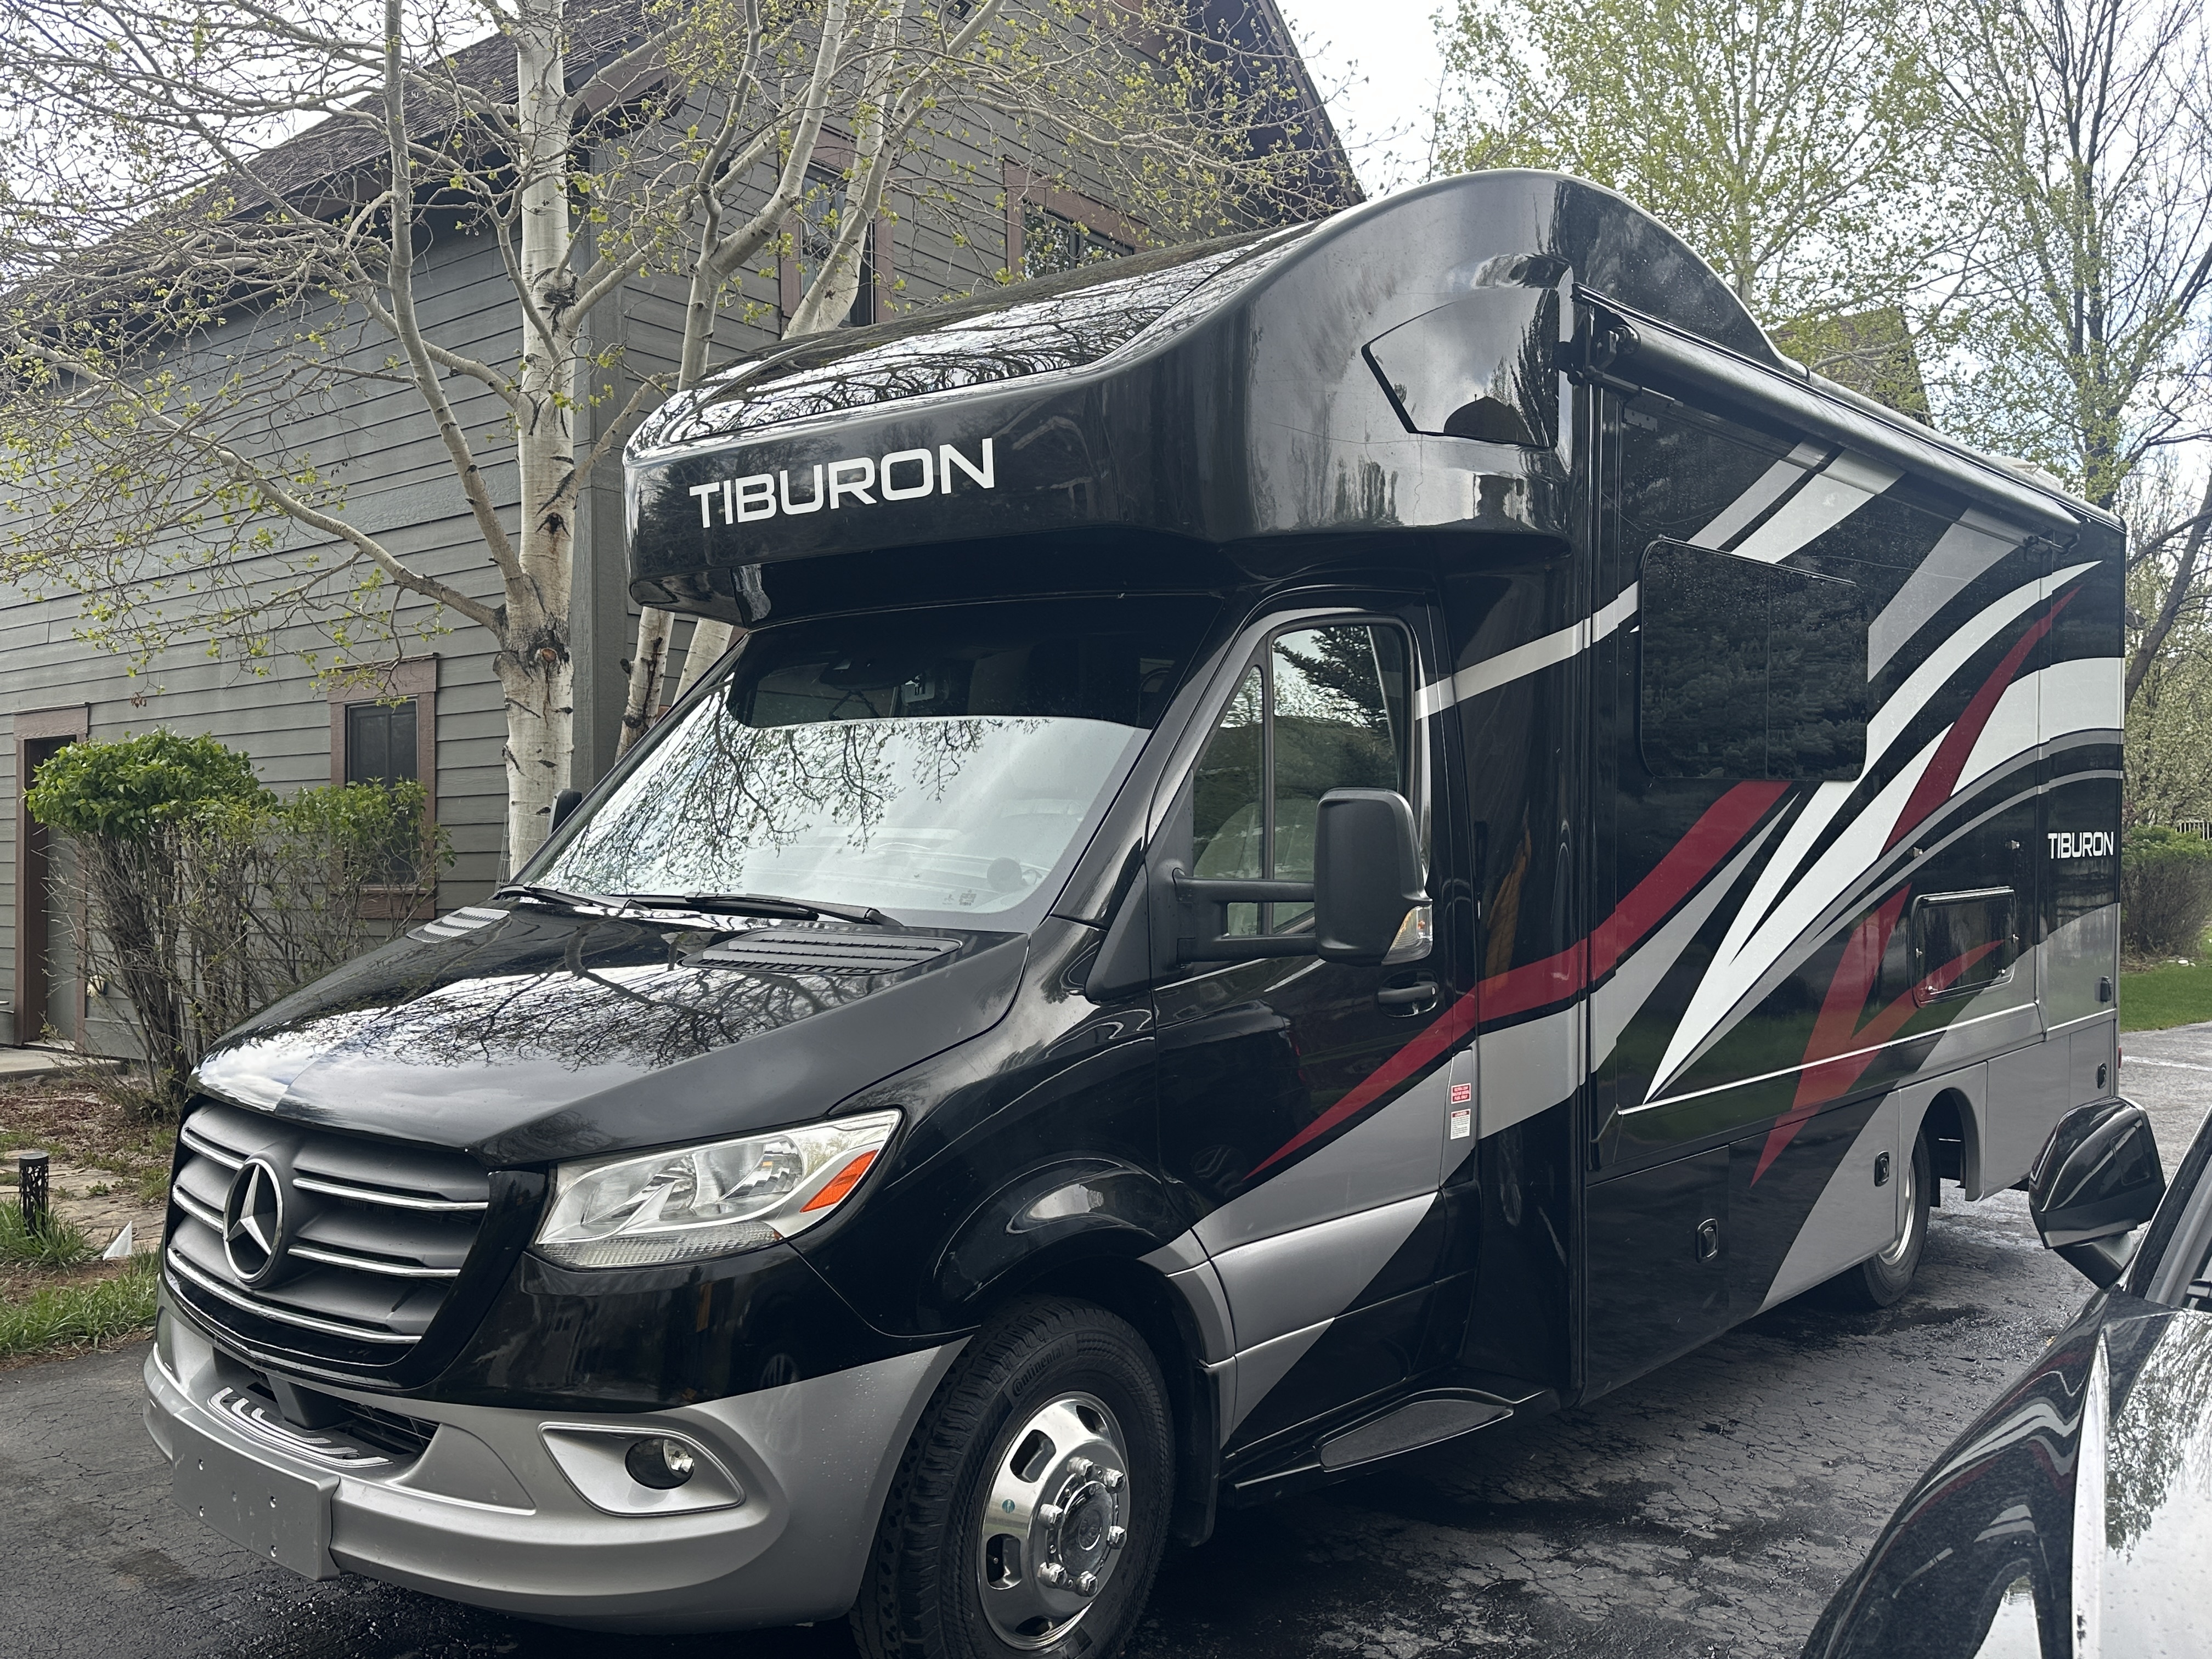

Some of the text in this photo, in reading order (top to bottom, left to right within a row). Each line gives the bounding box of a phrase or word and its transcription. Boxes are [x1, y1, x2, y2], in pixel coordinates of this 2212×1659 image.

[689, 437, 995, 528] TIBURON
[2047, 831, 2114, 860] TIBURON
[1012, 1342, 1064, 1396] Continental
